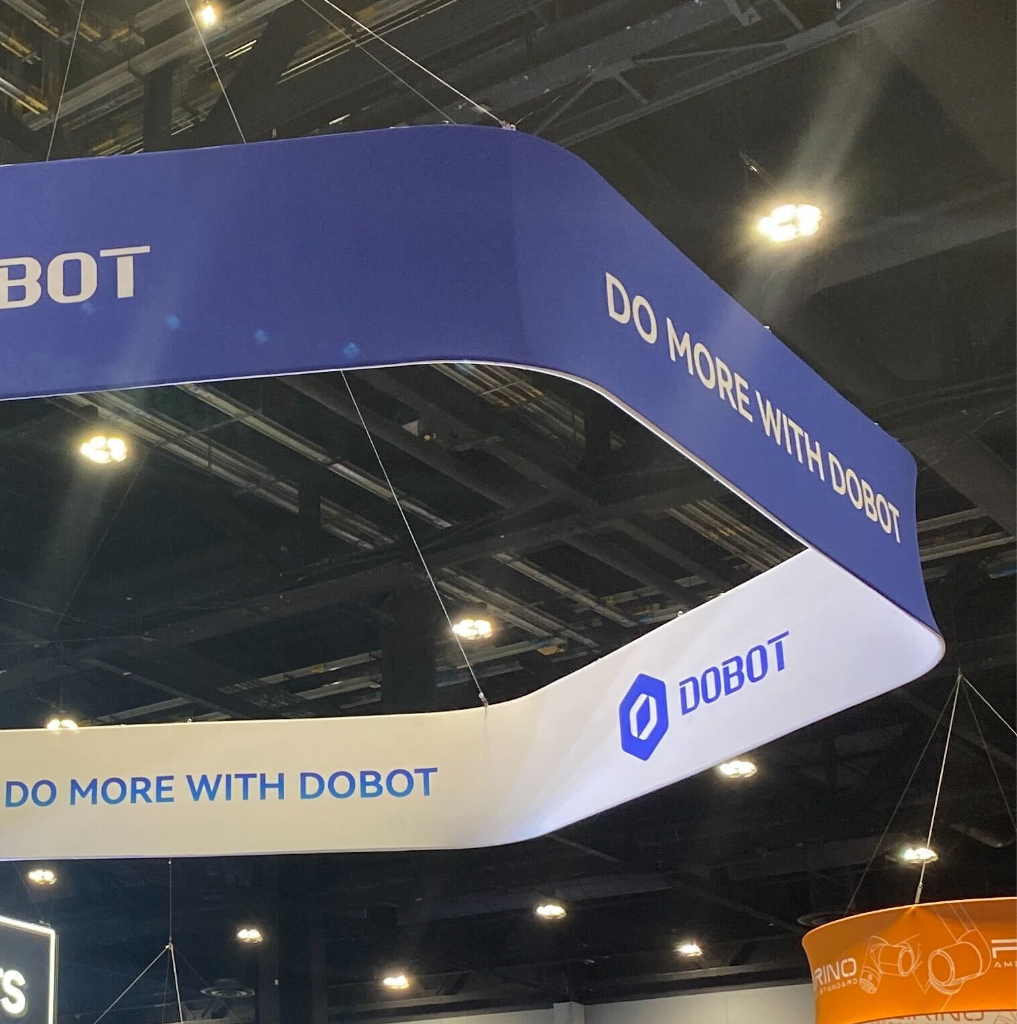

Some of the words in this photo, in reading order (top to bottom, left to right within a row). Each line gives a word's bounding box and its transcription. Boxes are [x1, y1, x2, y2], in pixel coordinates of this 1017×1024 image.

[605, 271, 658, 345] DO
[666, 316, 754, 423] MORE
[755, 389, 825, 482] WITH
[828, 451, 901, 544] DOBOT
[678, 630, 790, 716] DOBOT
[5, 779, 57, 808] DO
[69, 775, 175, 805] MORE
[185, 772, 285, 801] WITH
[299, 767, 438, 800] DOBOT
